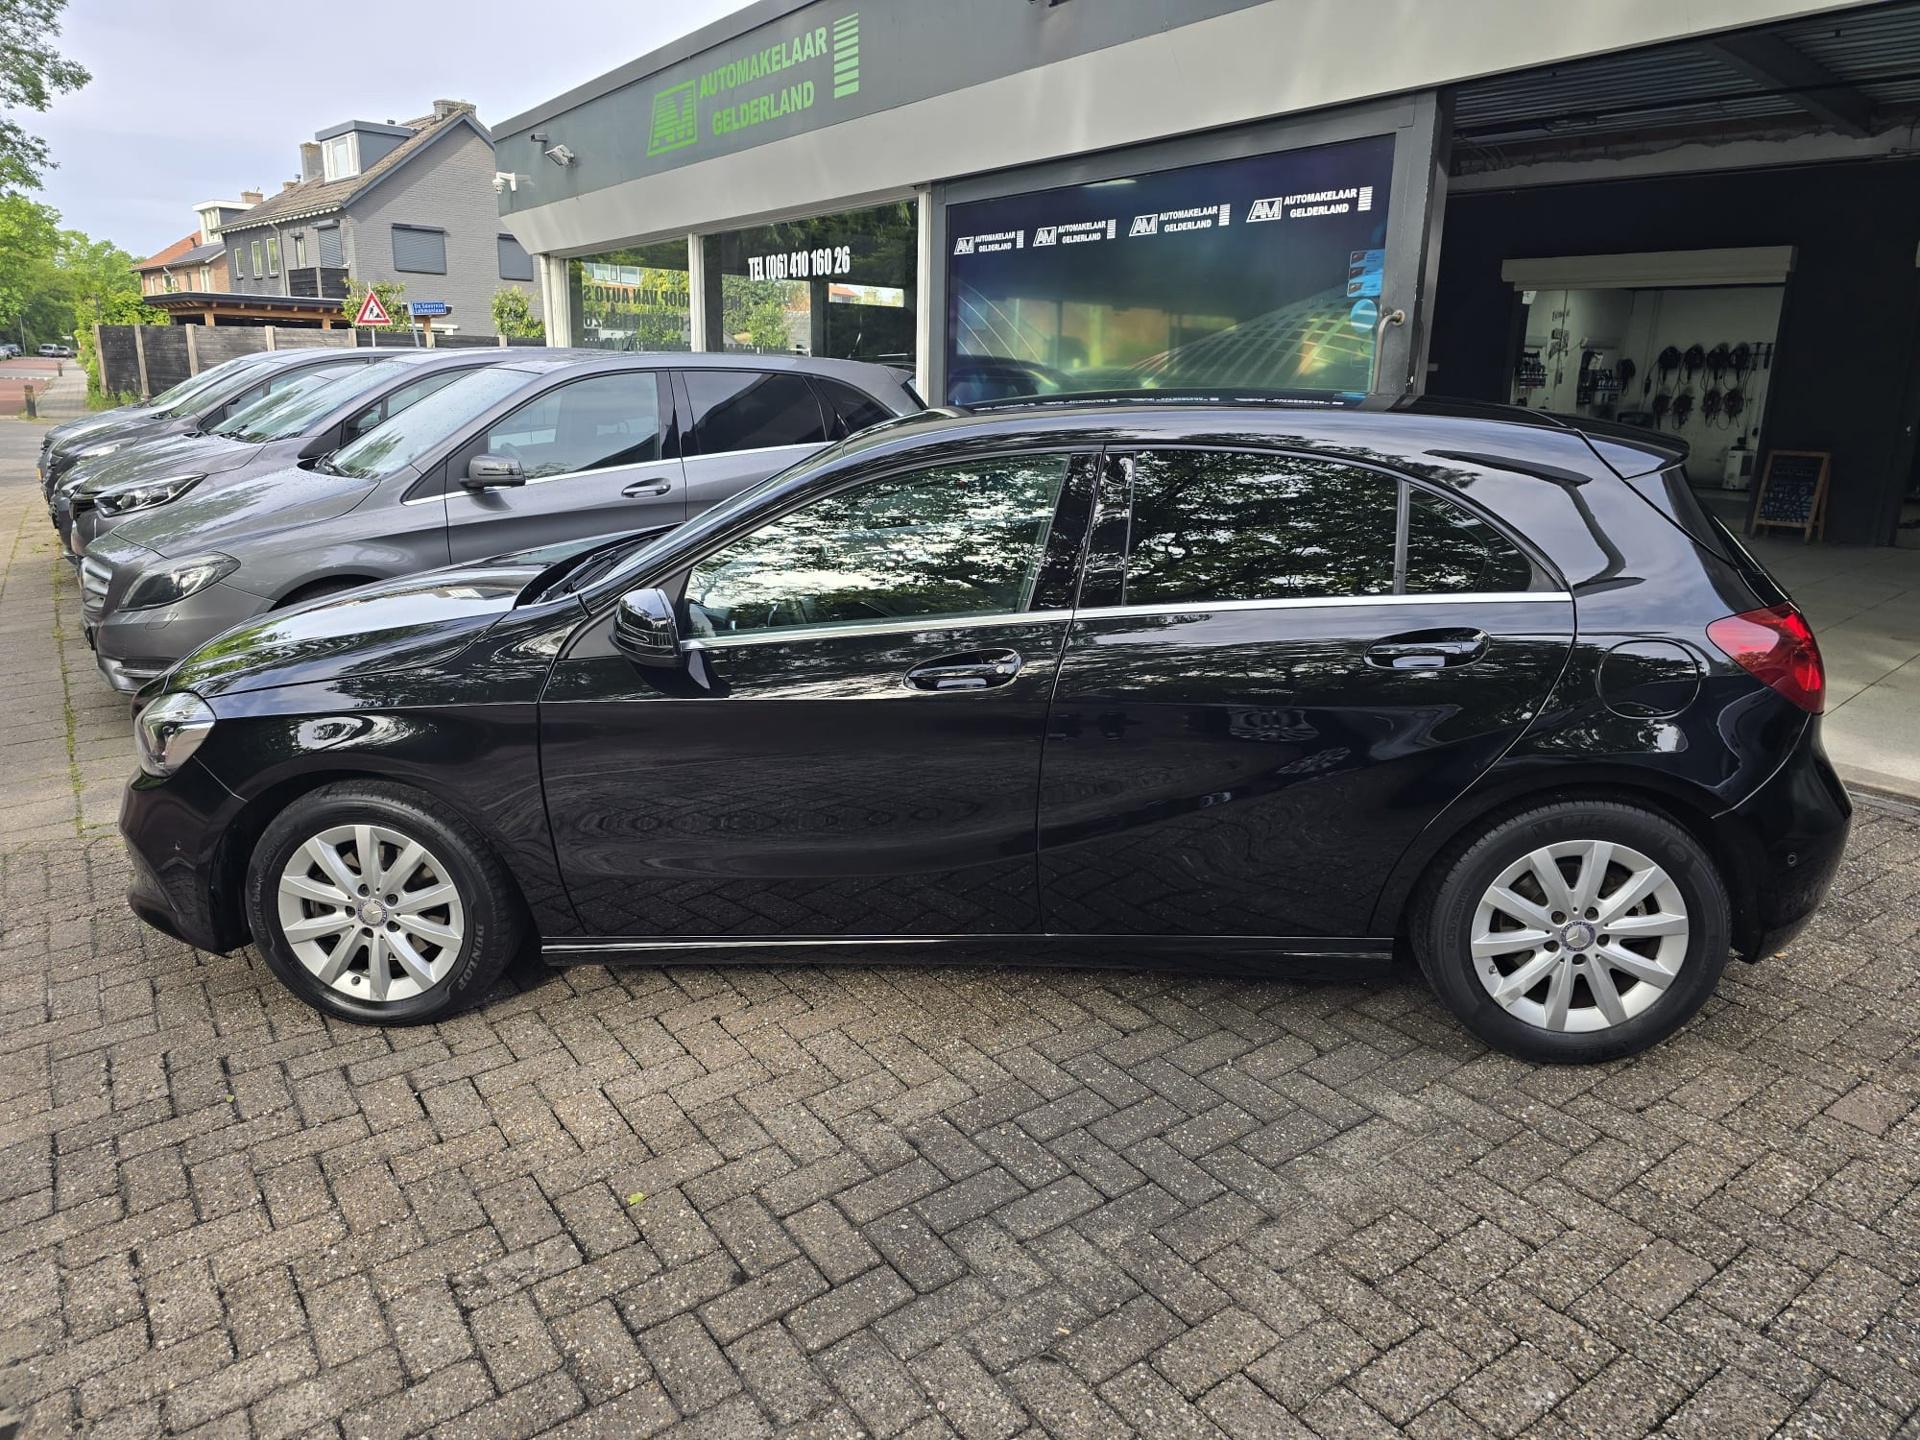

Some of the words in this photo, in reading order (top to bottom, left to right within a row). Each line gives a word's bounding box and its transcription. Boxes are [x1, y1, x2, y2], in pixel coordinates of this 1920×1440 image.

[700, 26, 828, 99] AUTOMAKELAAR
[711, 80, 815, 136] GELDERLAND
[1284, 188, 1357, 205] AUTOMAKELAAR
[1159, 205, 1218, 221] AUTOMAKELAAR
[1290, 203, 1349, 219] GELDERLAND
[1058, 220, 1106, 233] AUTOMAKELAAR
[1164, 219, 1212, 232] GELDERLAND
[975, 231, 1016, 243] AUTOMAKELAAR
[1062, 232, 1102, 244] GELDERLAND
[978, 242, 1012, 253] GELDERLAND
[748, 256, 765, 281] TEL
[765, 253, 788, 280] (06)
[790, 250, 809, 278] 410
[810, 247, 832, 276] 160
[834, 245, 851, 274] 26
[459, 924, 484, 991] DUNLOP
